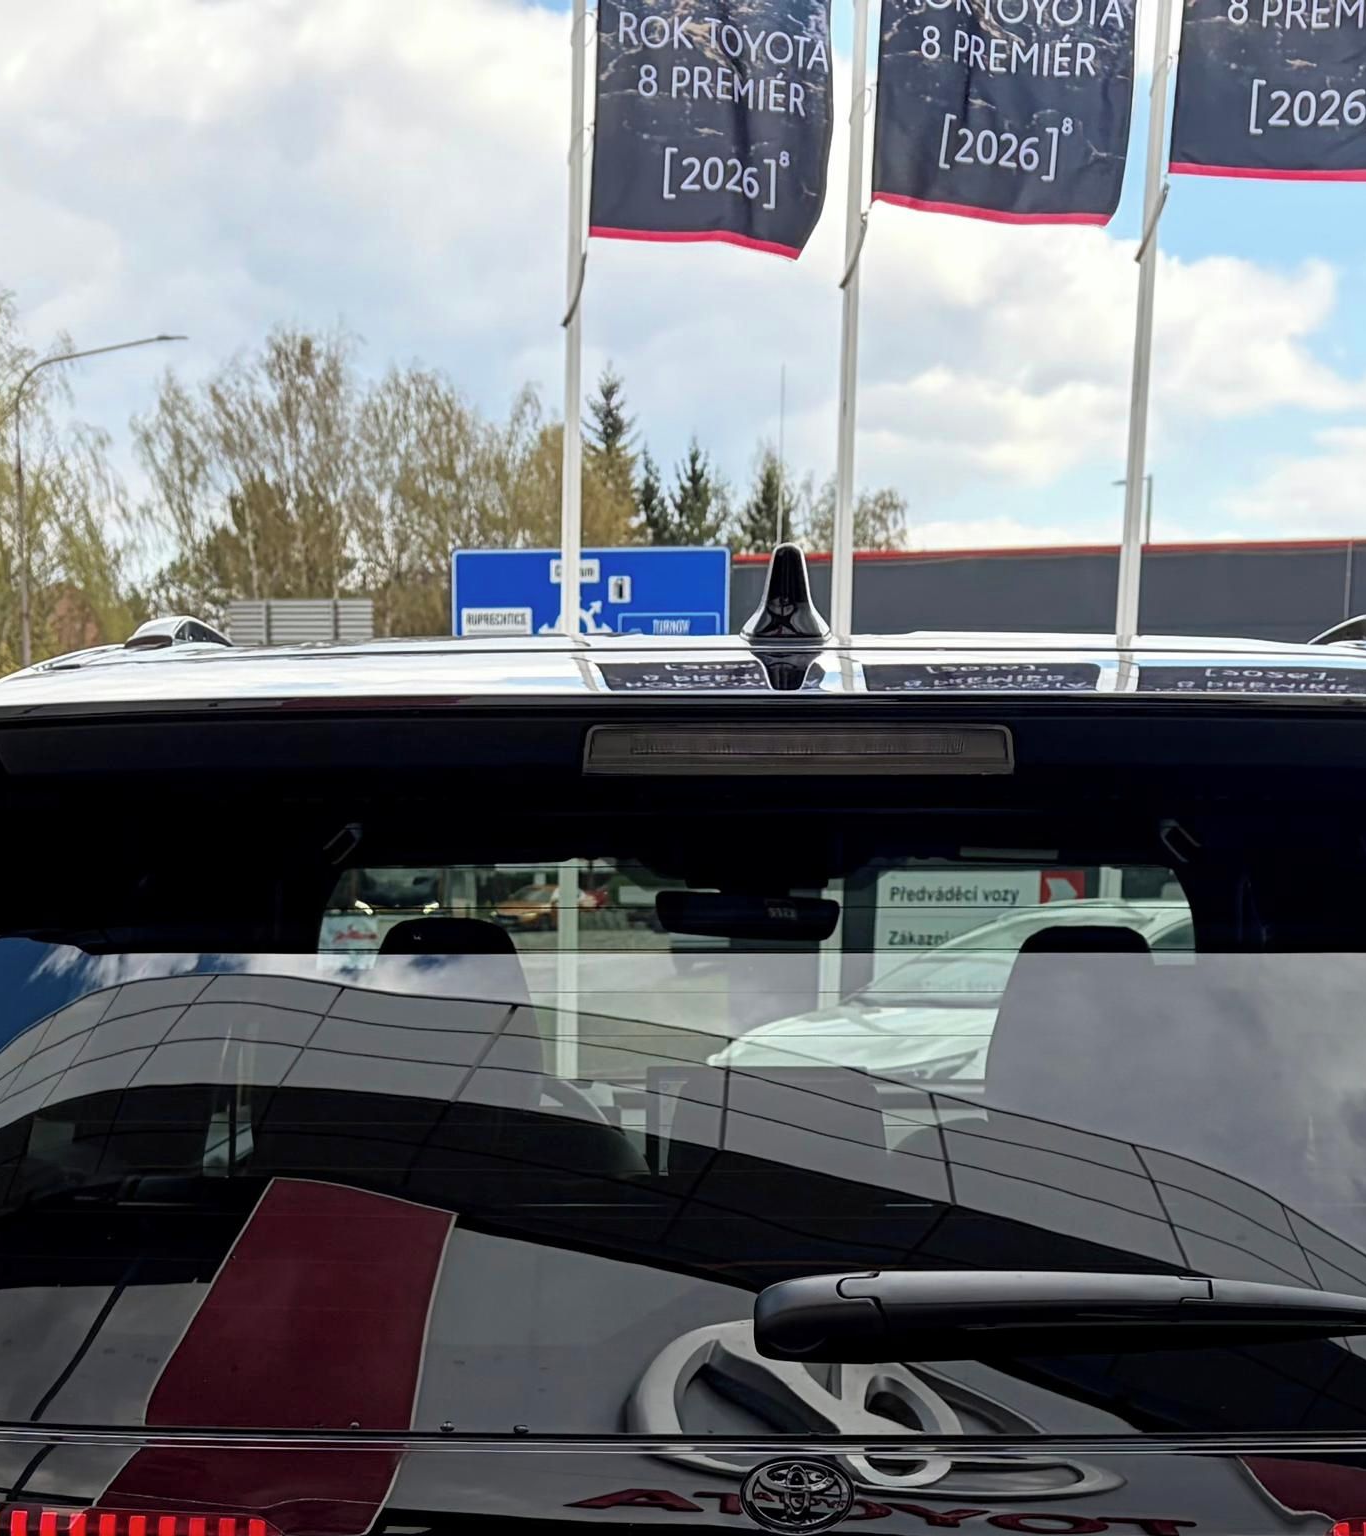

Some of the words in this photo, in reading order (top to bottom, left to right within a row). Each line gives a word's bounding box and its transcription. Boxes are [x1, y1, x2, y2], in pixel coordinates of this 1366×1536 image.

[618, 11, 693, 49] ROK
[704, 17, 830, 73] TOYOTA
[921, 26, 941, 59] 8
[953, 29, 1097, 77] PREMIÉR
[638, 64, 658, 97] 8
[671, 66, 806, 117] PREMIÉR
[889, 885, 978, 902] Předváděcí
[984, 888, 1020, 904] vozy
